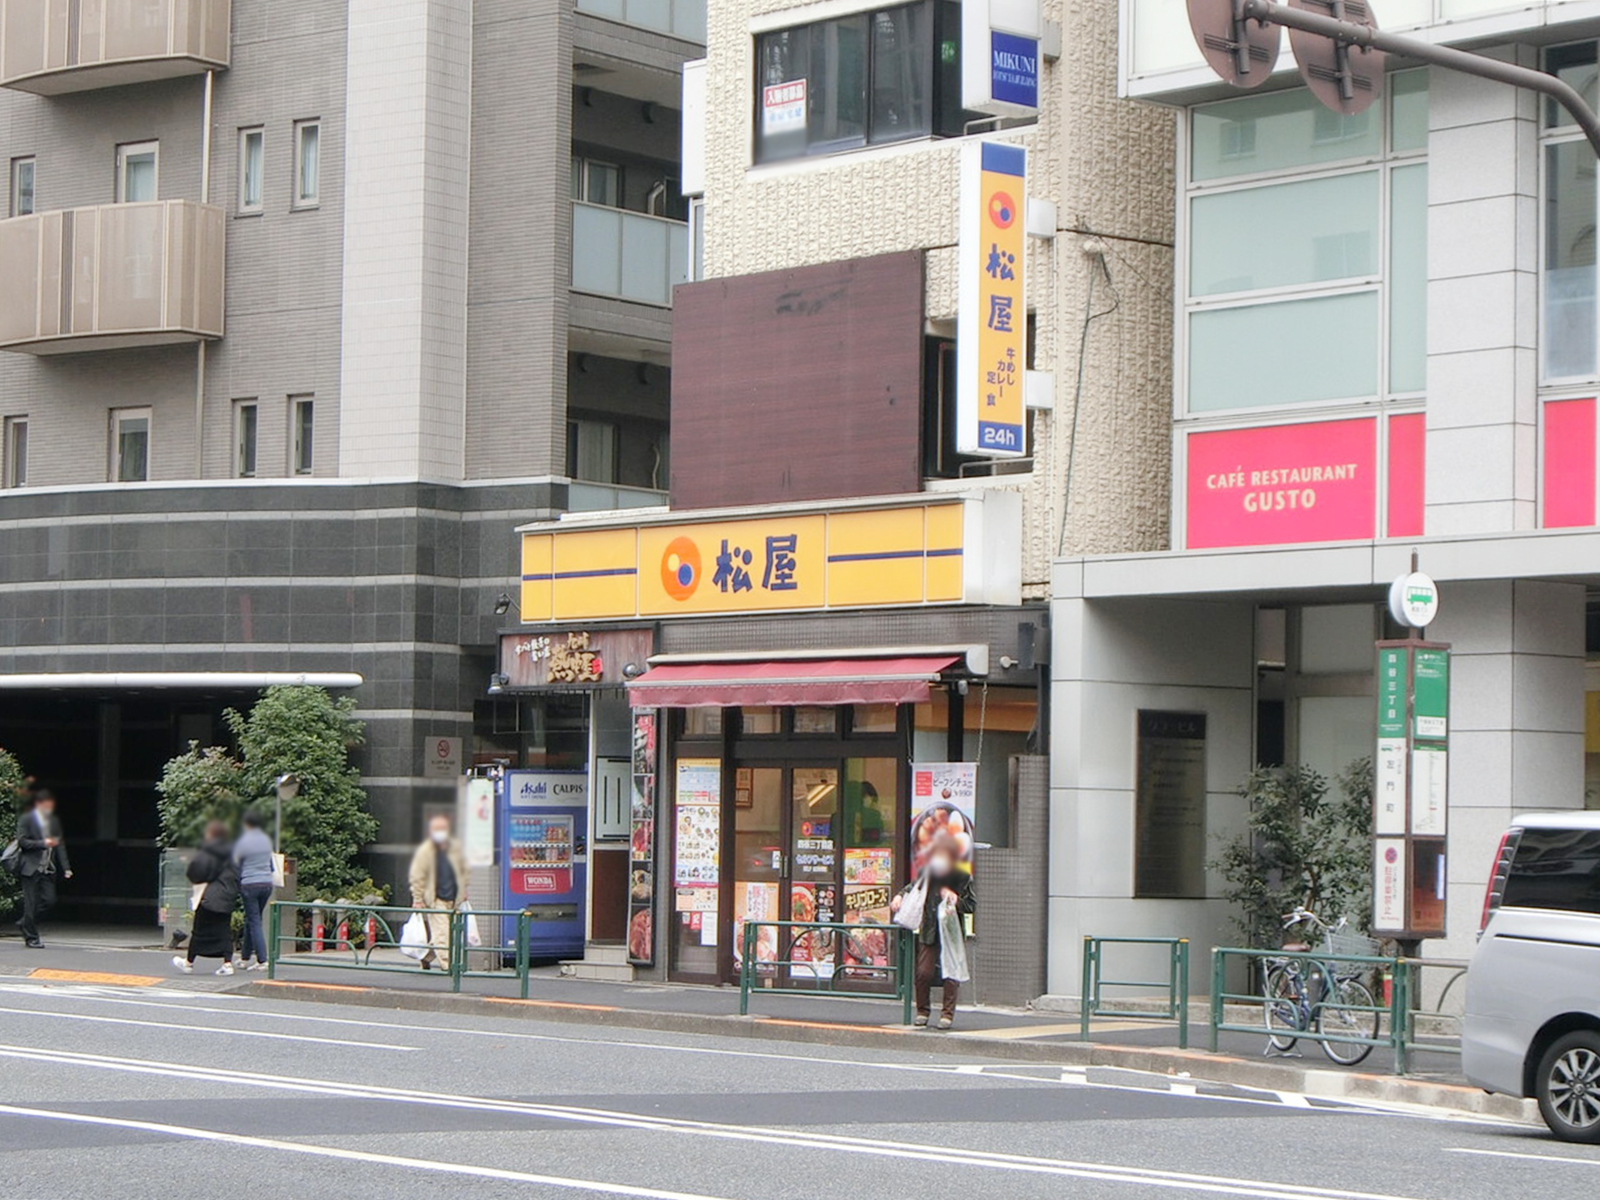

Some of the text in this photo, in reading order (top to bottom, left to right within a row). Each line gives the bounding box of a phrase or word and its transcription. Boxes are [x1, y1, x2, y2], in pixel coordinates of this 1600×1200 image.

[993, 50, 1036, 74] MIKUNI
[985, 242, 1015, 333] 松屋
[997, 360, 1006, 398] カレー
[1006, 347, 1015, 386] 牛めし
[986, 371, 996, 406] 定食
[984, 427, 1015, 446] 24h
[1206, 463, 1358, 489] CAFÉ RESTAURANT
[1243, 488, 1317, 512] GUSTO
[712, 534, 798, 594] 松屋
[520, 782, 547, 795] Asahi
[553, 783, 584, 796] CALPIS
[527, 876, 553, 885] WONDA
